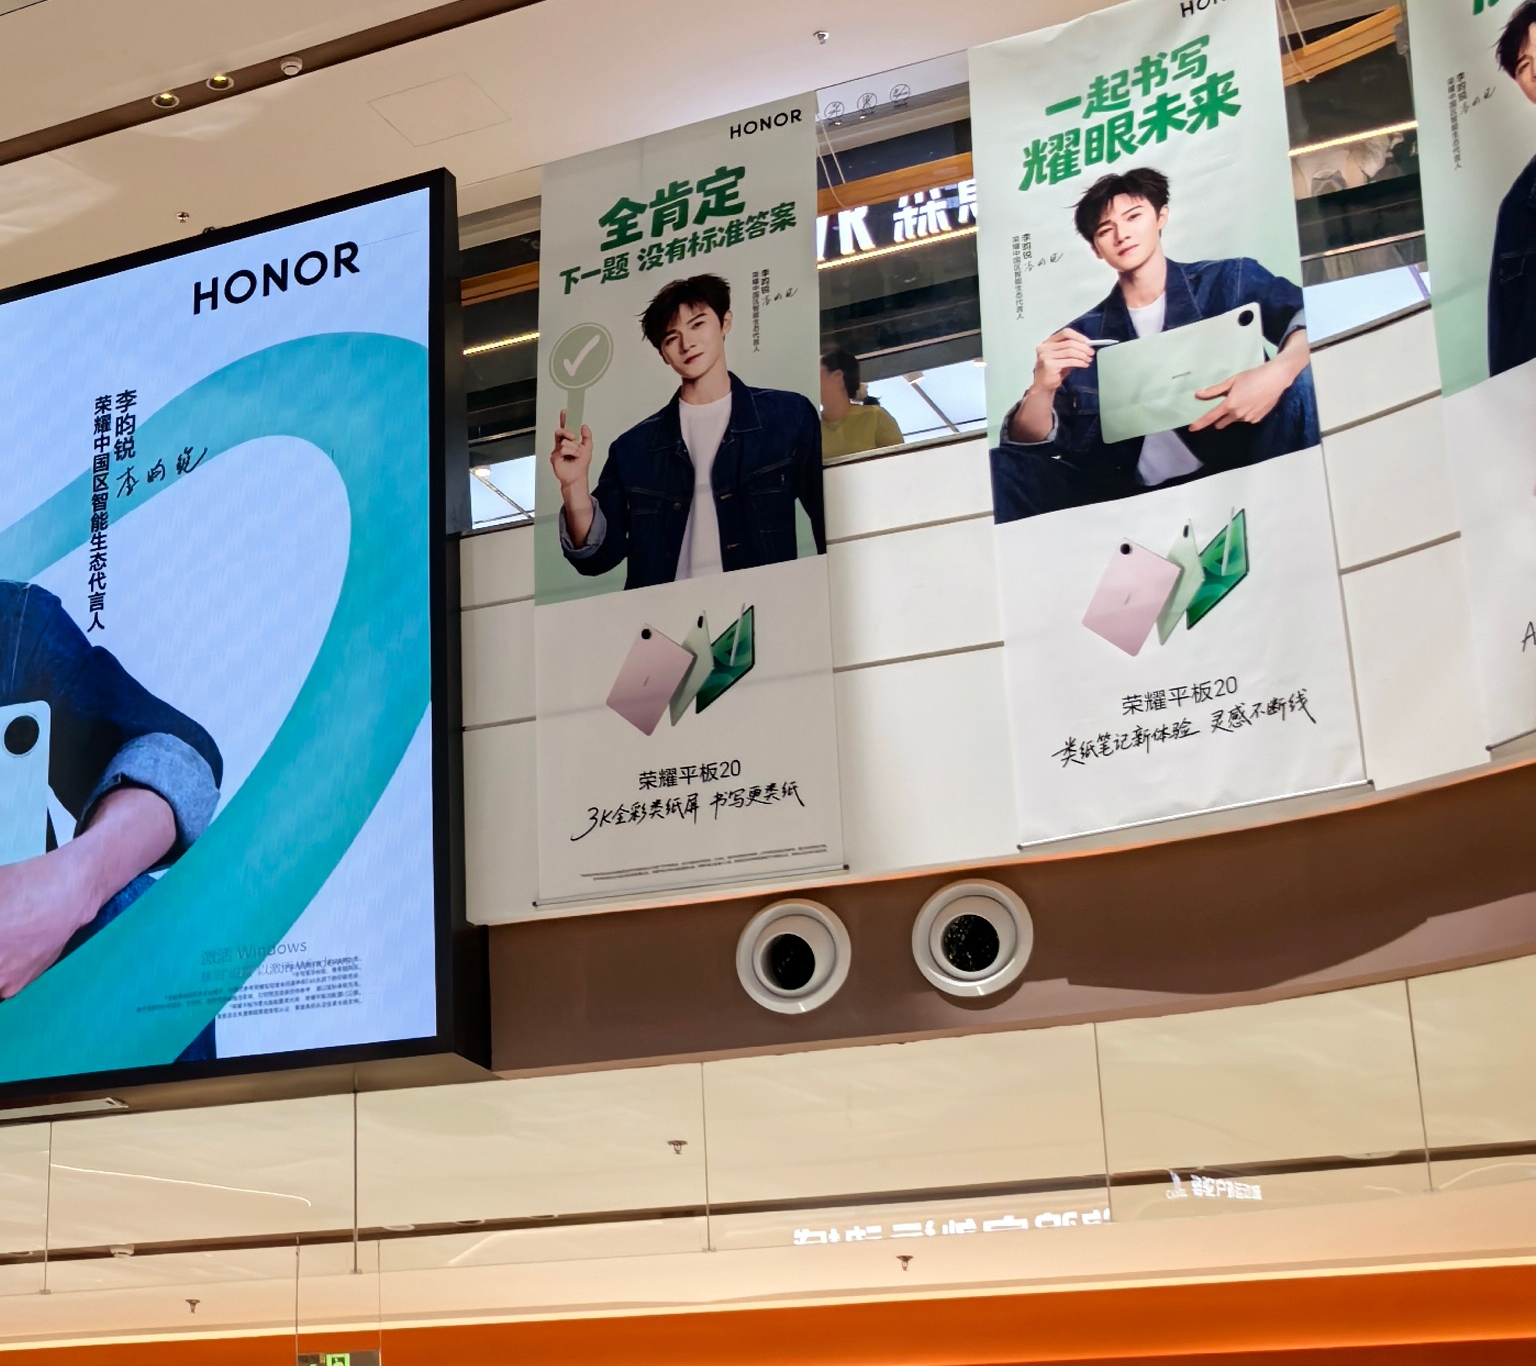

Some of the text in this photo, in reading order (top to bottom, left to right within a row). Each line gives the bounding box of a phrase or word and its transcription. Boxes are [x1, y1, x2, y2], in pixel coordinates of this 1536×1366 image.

[1045, 34, 1211, 119] 一起书写
[730, 109, 802, 139] HONOR
[1018, 70, 1242, 191] 耀眼未来
[598, 166, 745, 251] 全肯定
[193, 241, 360, 315] HONOR
[559, 201, 797, 295] 下一题 没有标准答案
[114, 389, 136, 461] 李昀锐
[86, 395, 112, 633] 荣耀中国区智能生态代言人
[1051, 688, 1317, 768] 类纸笔记新体验 灵感不断线
[1121, 675, 1238, 715] 荣耀平板20
[570, 781, 805, 841] 3K全彩类纸屏 书写更类纸
[638, 759, 742, 791] 荣耀平板20
[237, 941, 307, 960] Windows
